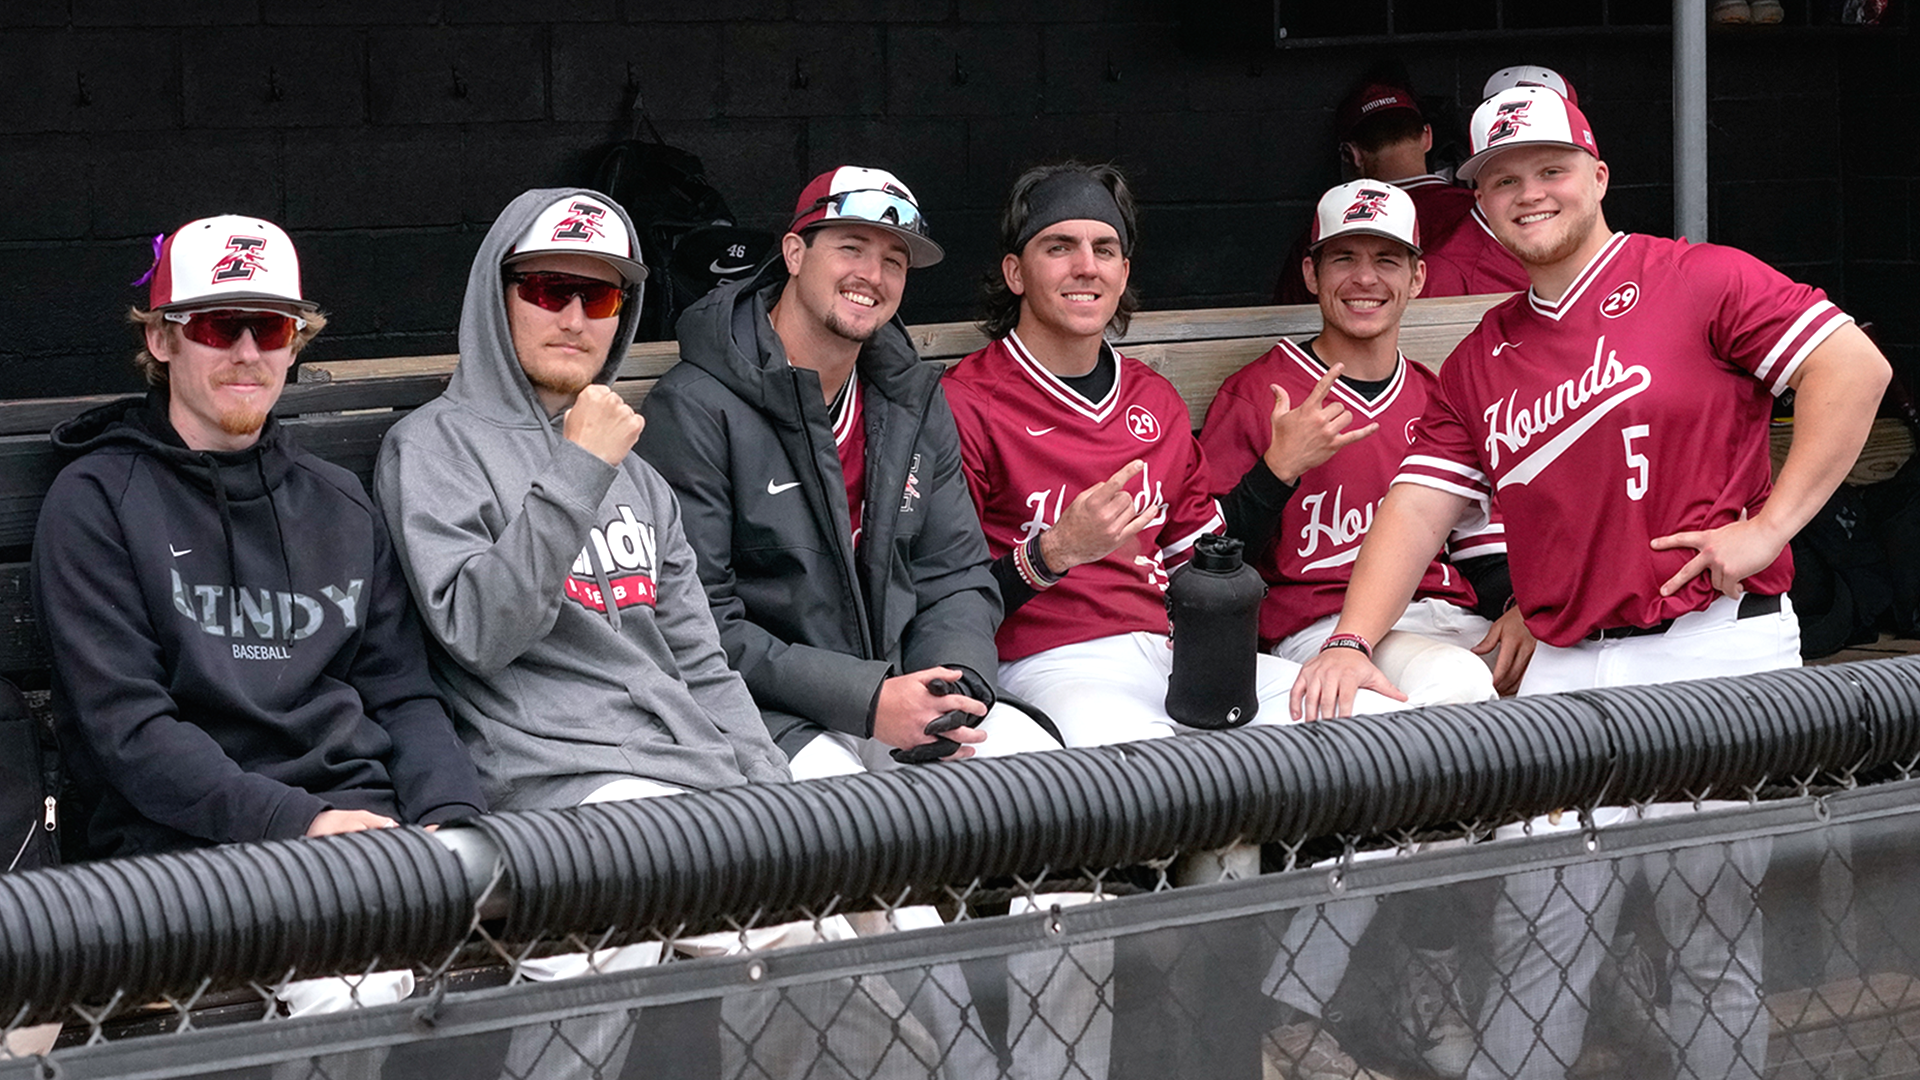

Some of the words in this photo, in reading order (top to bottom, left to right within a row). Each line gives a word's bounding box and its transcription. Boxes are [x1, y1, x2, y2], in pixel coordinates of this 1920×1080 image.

[1361, 96, 1398, 113] HOUNDS
[726, 243, 746, 258] 46
[1604, 288, 1636, 312] 29
[1483, 335, 1625, 471] Hounds
[1130, 413, 1155, 434] 29
[1621, 424, 1650, 501] 5
[232, 643, 291, 660] BASEBALL
